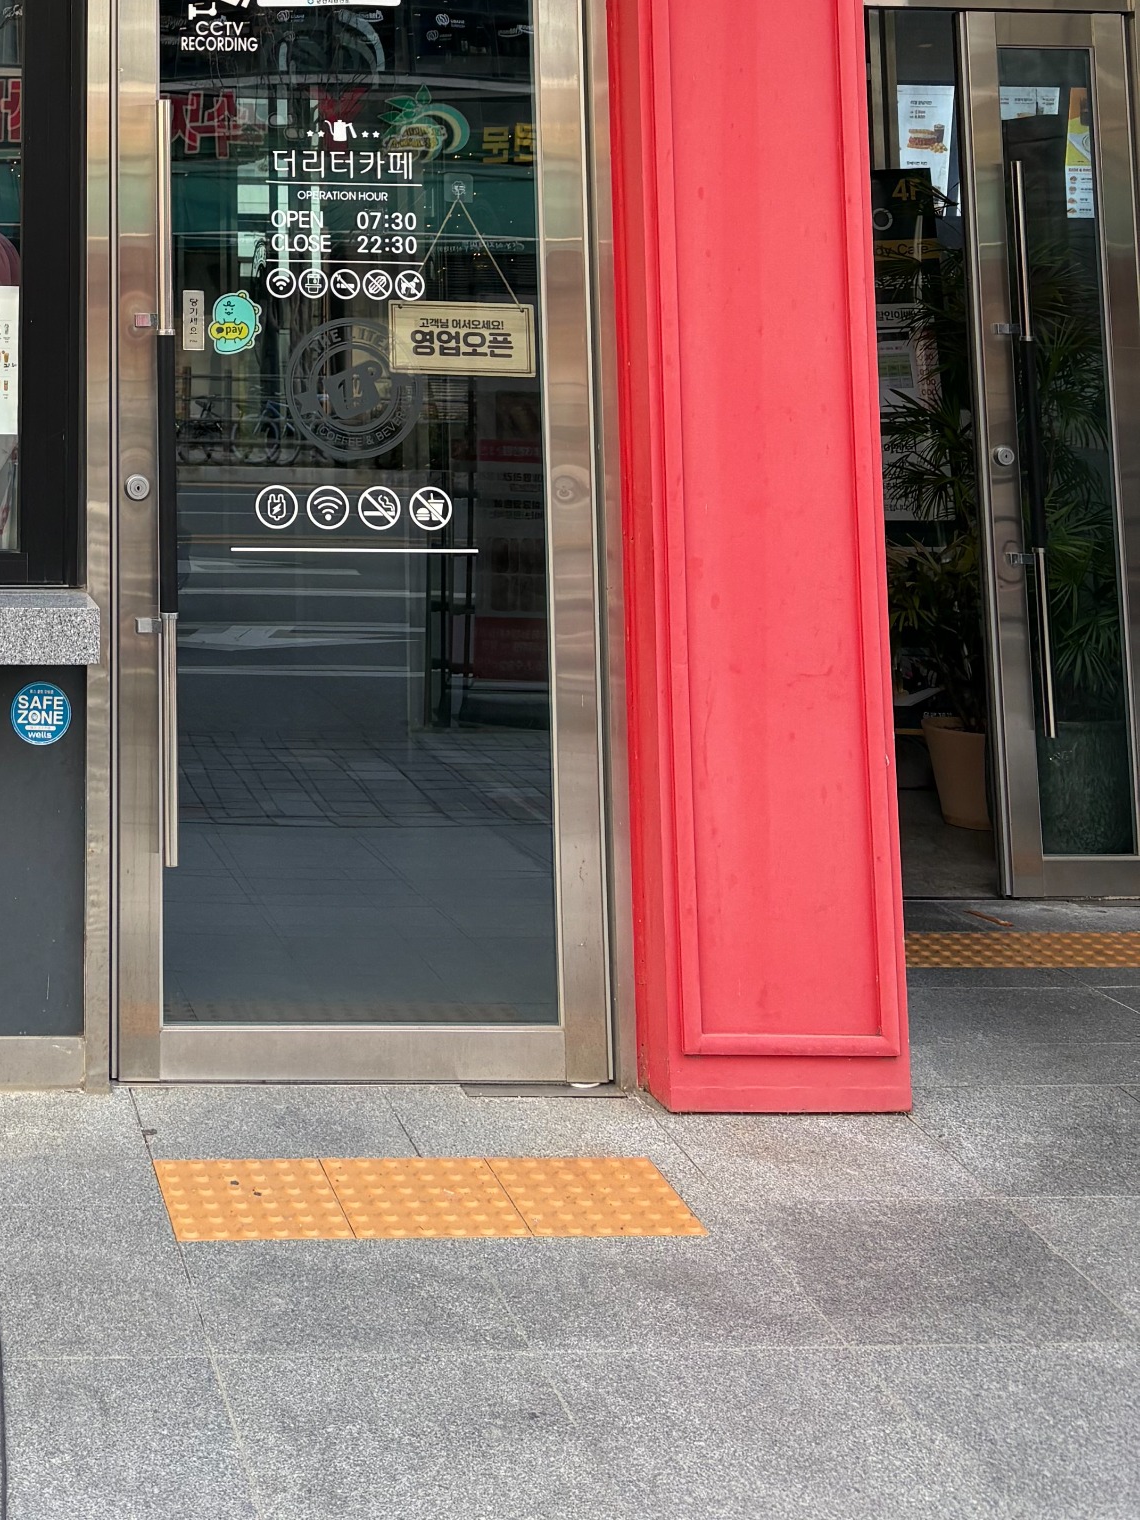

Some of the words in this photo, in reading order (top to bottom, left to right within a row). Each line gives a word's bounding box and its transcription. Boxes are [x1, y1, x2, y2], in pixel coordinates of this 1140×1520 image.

[196, 21, 244, 36] CCTV
[181, 37, 258, 52] RECORDING
[273, 150, 413, 180] 더리터카페
[297, 191, 356, 201] OPERATION
[358, 192, 388, 201] HOUR
[271, 210, 324, 228] OPEN
[356, 212, 417, 230] 07:30
[271, 234, 332, 252] CLOSE
[356, 236, 417, 254] 22:30
[226, 326, 243, 335] pay
[419, 318, 449, 329] 고객님
[452, 319, 504, 330] 어서오세요!
[410, 329, 514, 358] 영업오픈
[318, 425, 363, 447] COFFEE
[18, 695, 64, 710] SAFE
[17, 710, 64, 725] ZONE
